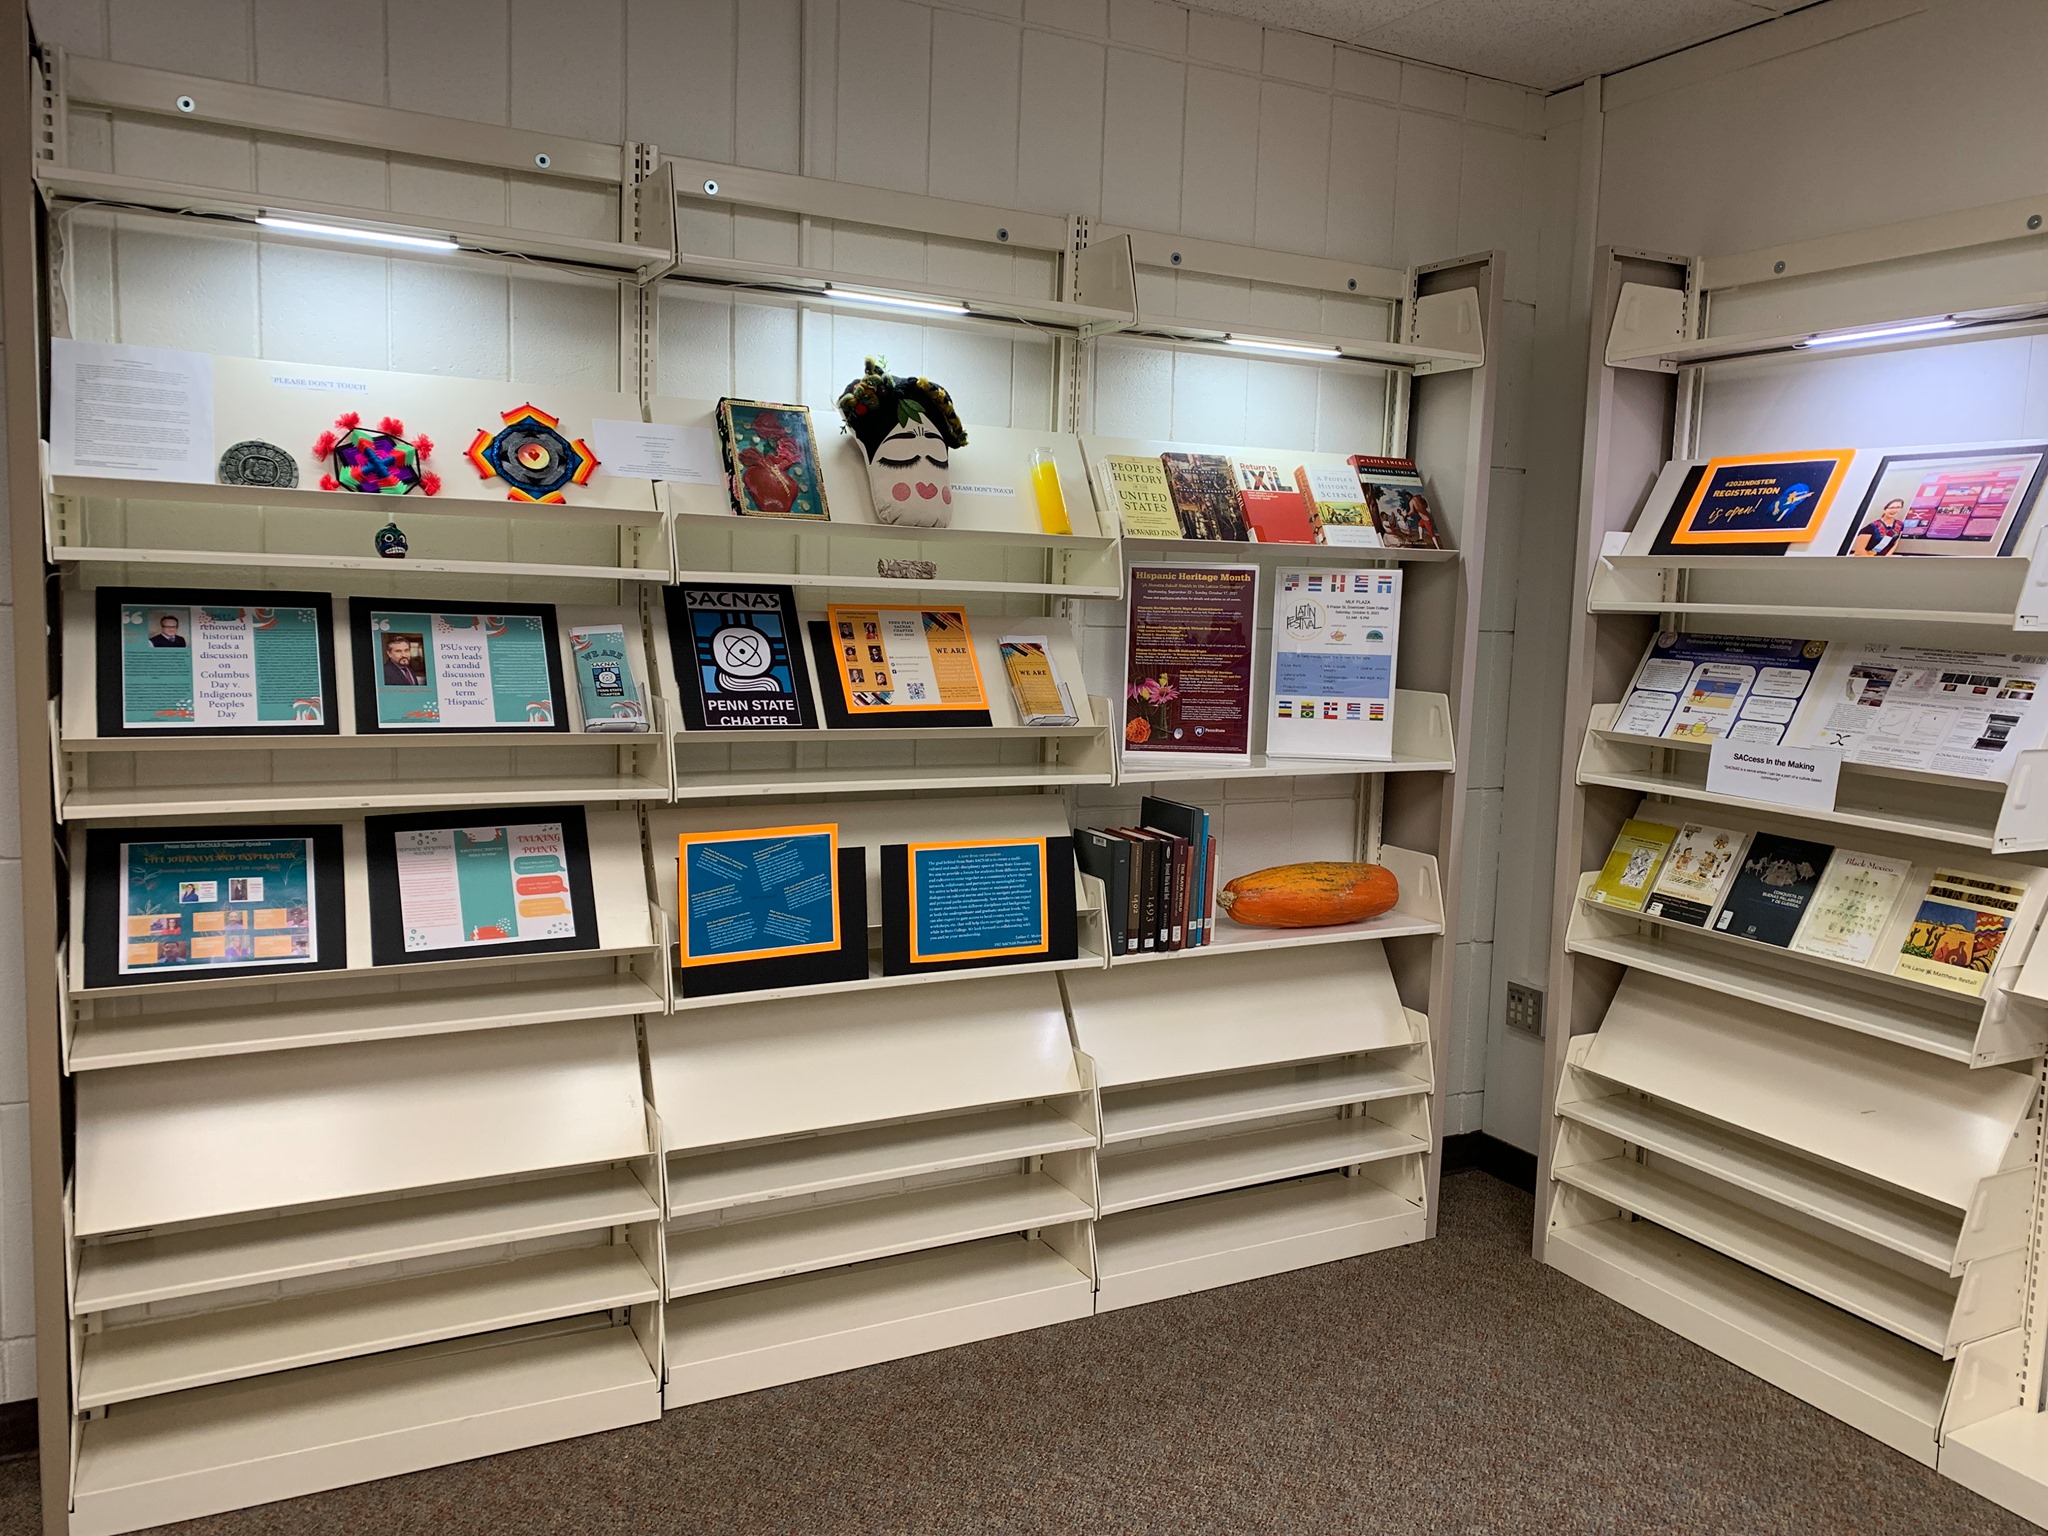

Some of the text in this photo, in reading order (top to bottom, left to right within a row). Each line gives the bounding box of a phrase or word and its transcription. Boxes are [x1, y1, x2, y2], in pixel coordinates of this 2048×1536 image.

[274, 377, 306, 386] PLEASE
[336, 382, 366, 390] TOUCH
[1110, 462, 1161, 474] PEOPLE'S
[1114, 473, 1163, 484] HISTORY
[1118, 491, 1167, 502] UNITED
[1713, 487, 1780, 497] REGISTRATION
[1124, 502, 1168, 512] STATES
[1708, 498, 1763, 525] is open!
[1127, 528, 1160, 537] HOWARD
[1136, 572, 1177, 581] Hispanic
[1178, 573, 1218, 582] Heritage
[686, 591, 780, 608] SACNAS
[581, 650, 623, 661] WE ARE
[211, 681, 230, 690] Day
[200, 691, 252, 700] Indigenous
[209, 700, 244, 709] Peoples
[444, 698, 487, 707] "Hispanic"
[708, 700, 795, 711] PENN STATE
[218, 710, 236, 719] Day
[720, 716, 788, 725] CHAPTER
[1734, 753, 1764, 764] SACcess
[1788, 760, 1815, 772] Making
[516, 834, 561, 843] TALKING
[522, 845, 558, 854] POINTS
[1846, 858, 1893, 872] Black Mexico
[1968, 894, 2018, 911] AMERICA
[1146, 897, 1155, 922] 1493
[1933, 971, 1957, 980] Matthew
[1958, 977, 1977, 985] Restall
